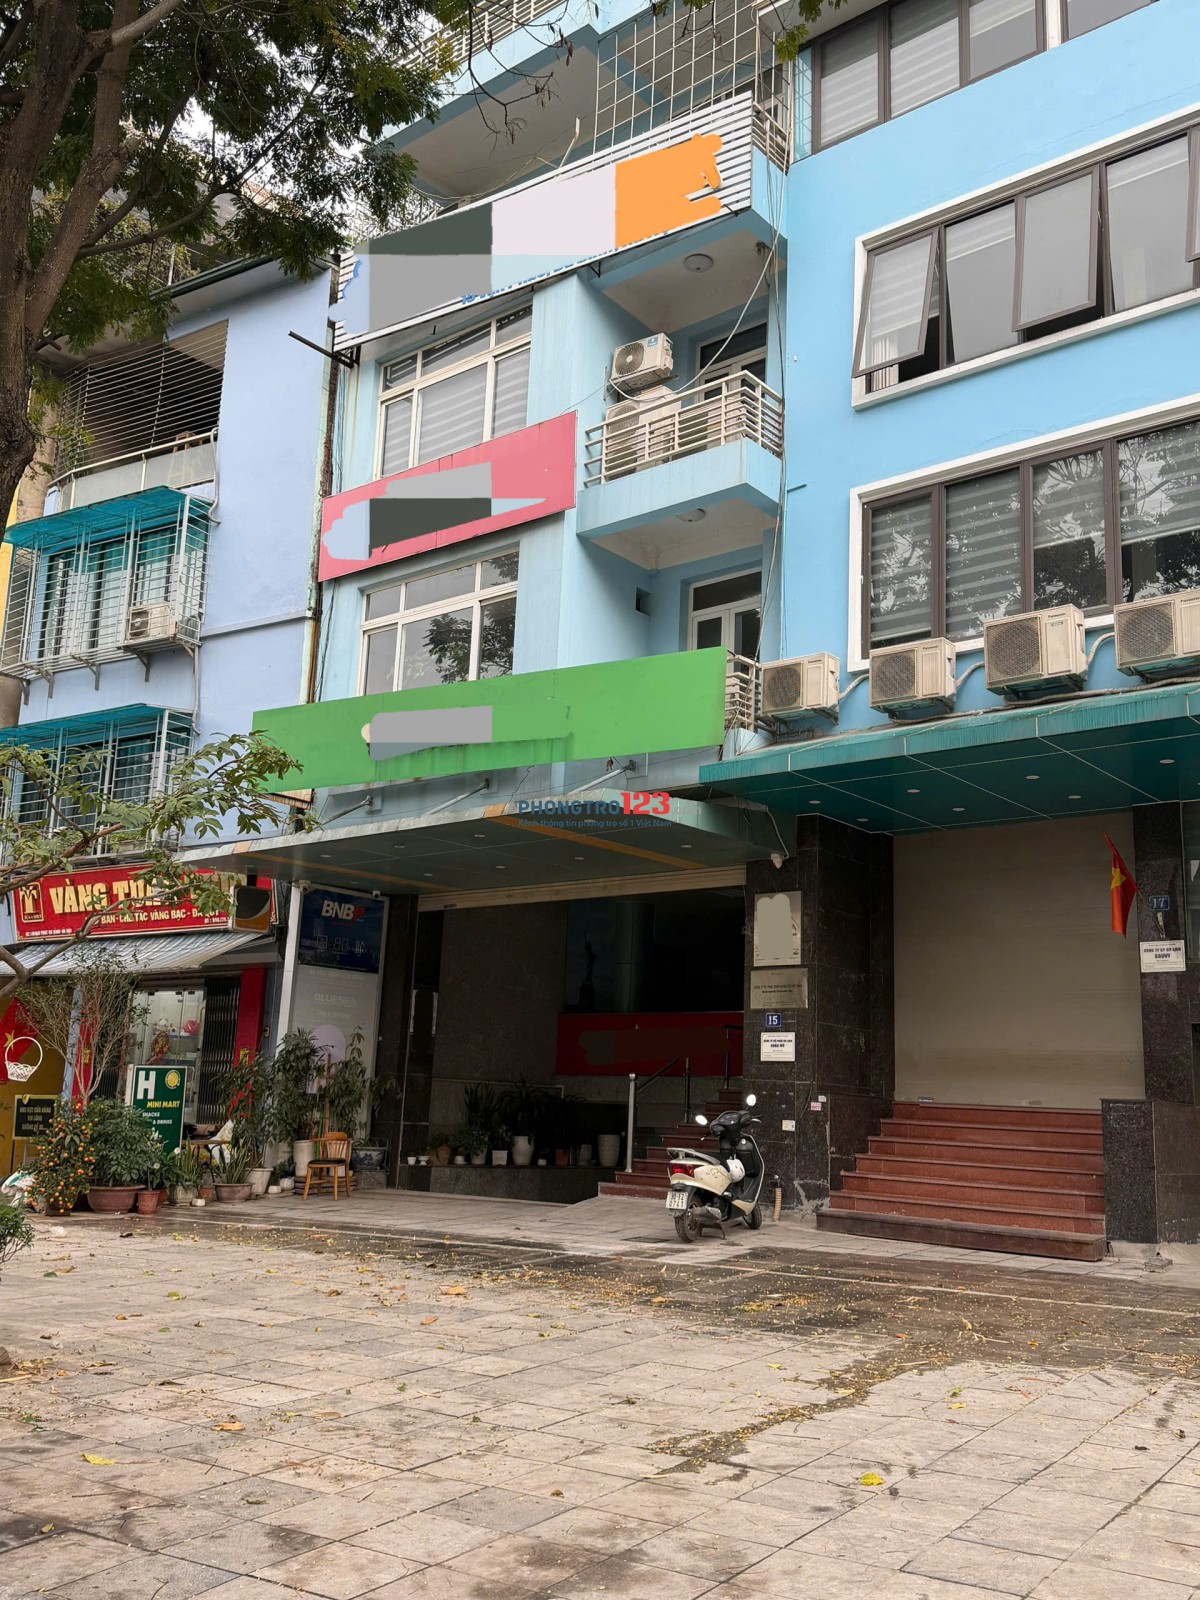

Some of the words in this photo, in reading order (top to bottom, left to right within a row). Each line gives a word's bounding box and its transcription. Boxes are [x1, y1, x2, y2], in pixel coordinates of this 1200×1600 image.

[49, 878, 108, 914] VÀNG
[1153, 897, 1165, 909] 17
[768, 1015, 778, 1025] 15
[137, 1071, 156, 1100] H
[162, 1100, 180, 1108] MART
